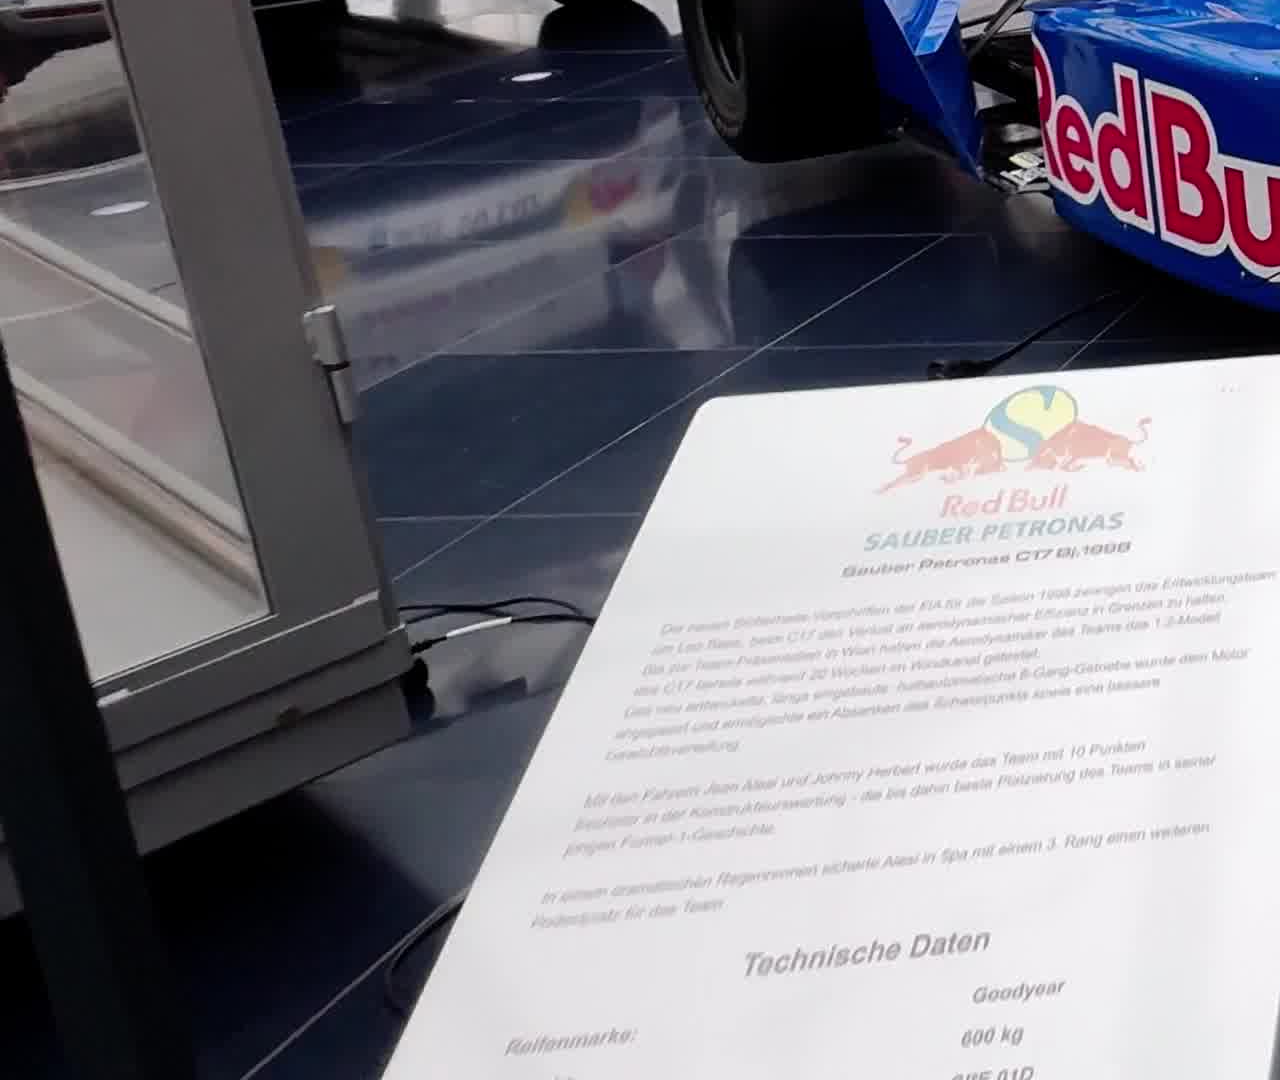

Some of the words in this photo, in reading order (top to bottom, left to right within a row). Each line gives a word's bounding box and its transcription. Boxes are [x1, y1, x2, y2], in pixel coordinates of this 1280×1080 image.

[863, 524, 972, 552] SAUBER
[981, 512, 1126, 541] PETRONAS
[841, 563, 913, 579] Sauber
[918, 554, 1009, 573] Petronas
[743, 938, 901, 979] Technische
[909, 930, 992, 959] Daten
[971, 979, 1066, 1005] Goodyear
[999, 1023, 1024, 1048] kg
